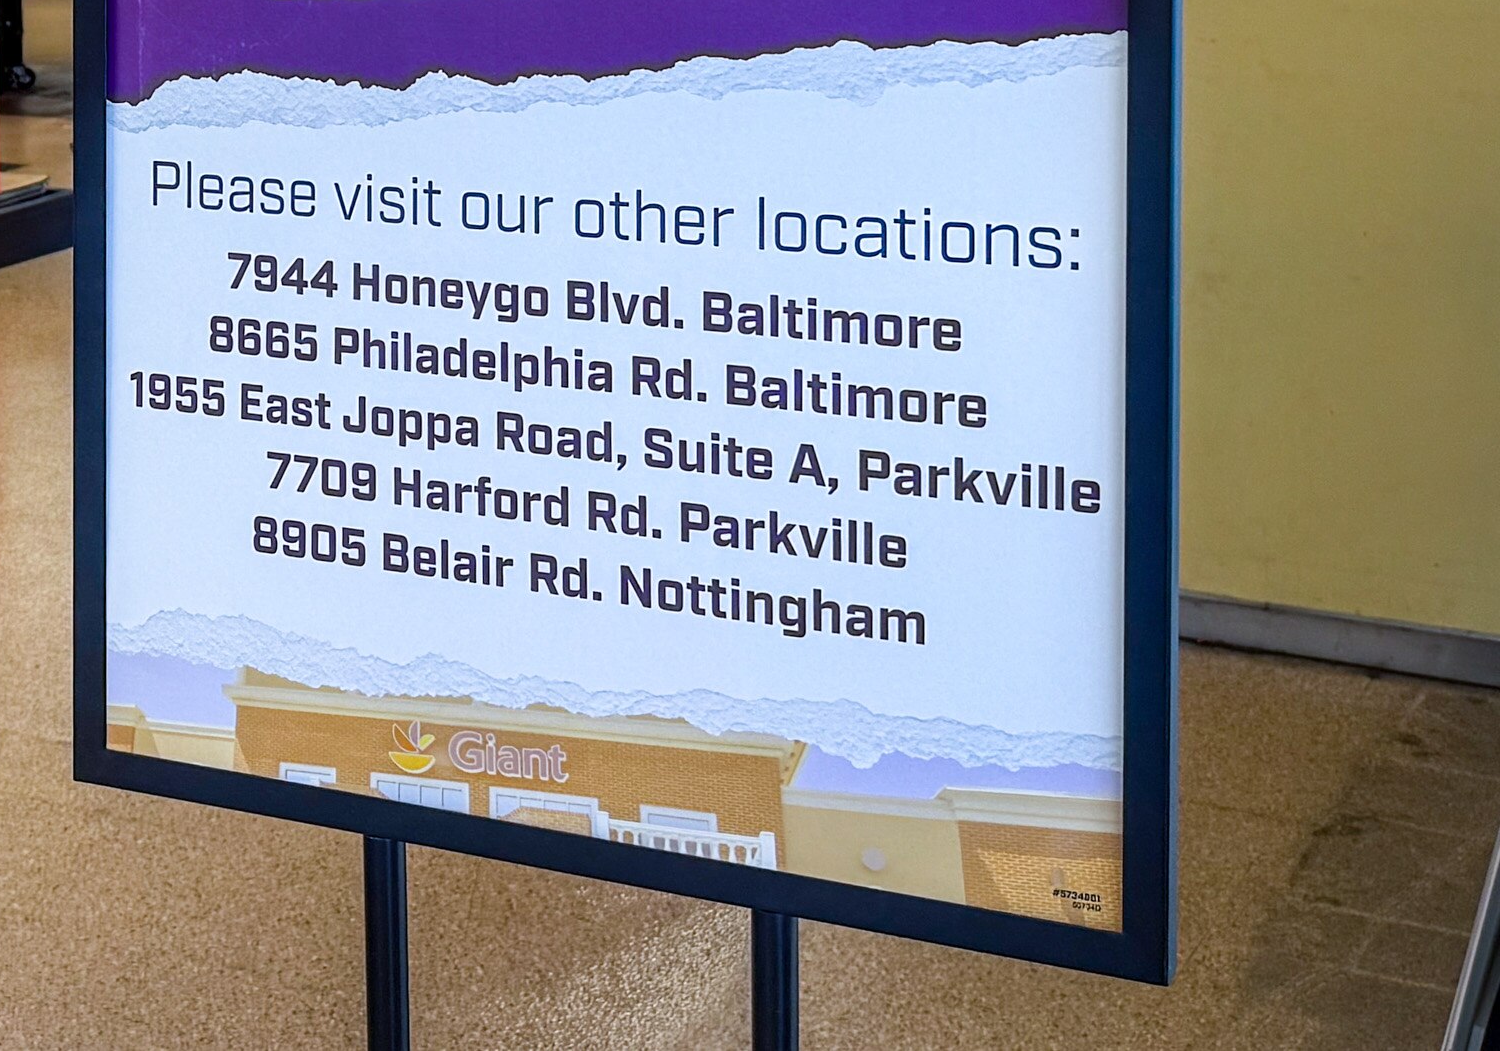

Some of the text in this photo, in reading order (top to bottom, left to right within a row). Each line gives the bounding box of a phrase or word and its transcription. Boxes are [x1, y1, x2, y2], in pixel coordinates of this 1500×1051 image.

[153, 161, 1079, 270] Please visit our other locations:
[228, 252, 961, 351] 7944 Honeygo Blvd. Baltimore
[210, 316, 986, 428] 8665 Philadelphia Rd. Baltimore
[131, 372, 1100, 513] 1955 East Joppa Road, Suite A, Parkville
[267, 451, 906, 568] 7709 Harford Rd. Parkville
[254, 516, 925, 645] 8905 Belair Rd. Nottingham
[448, 730, 569, 783] Giant
